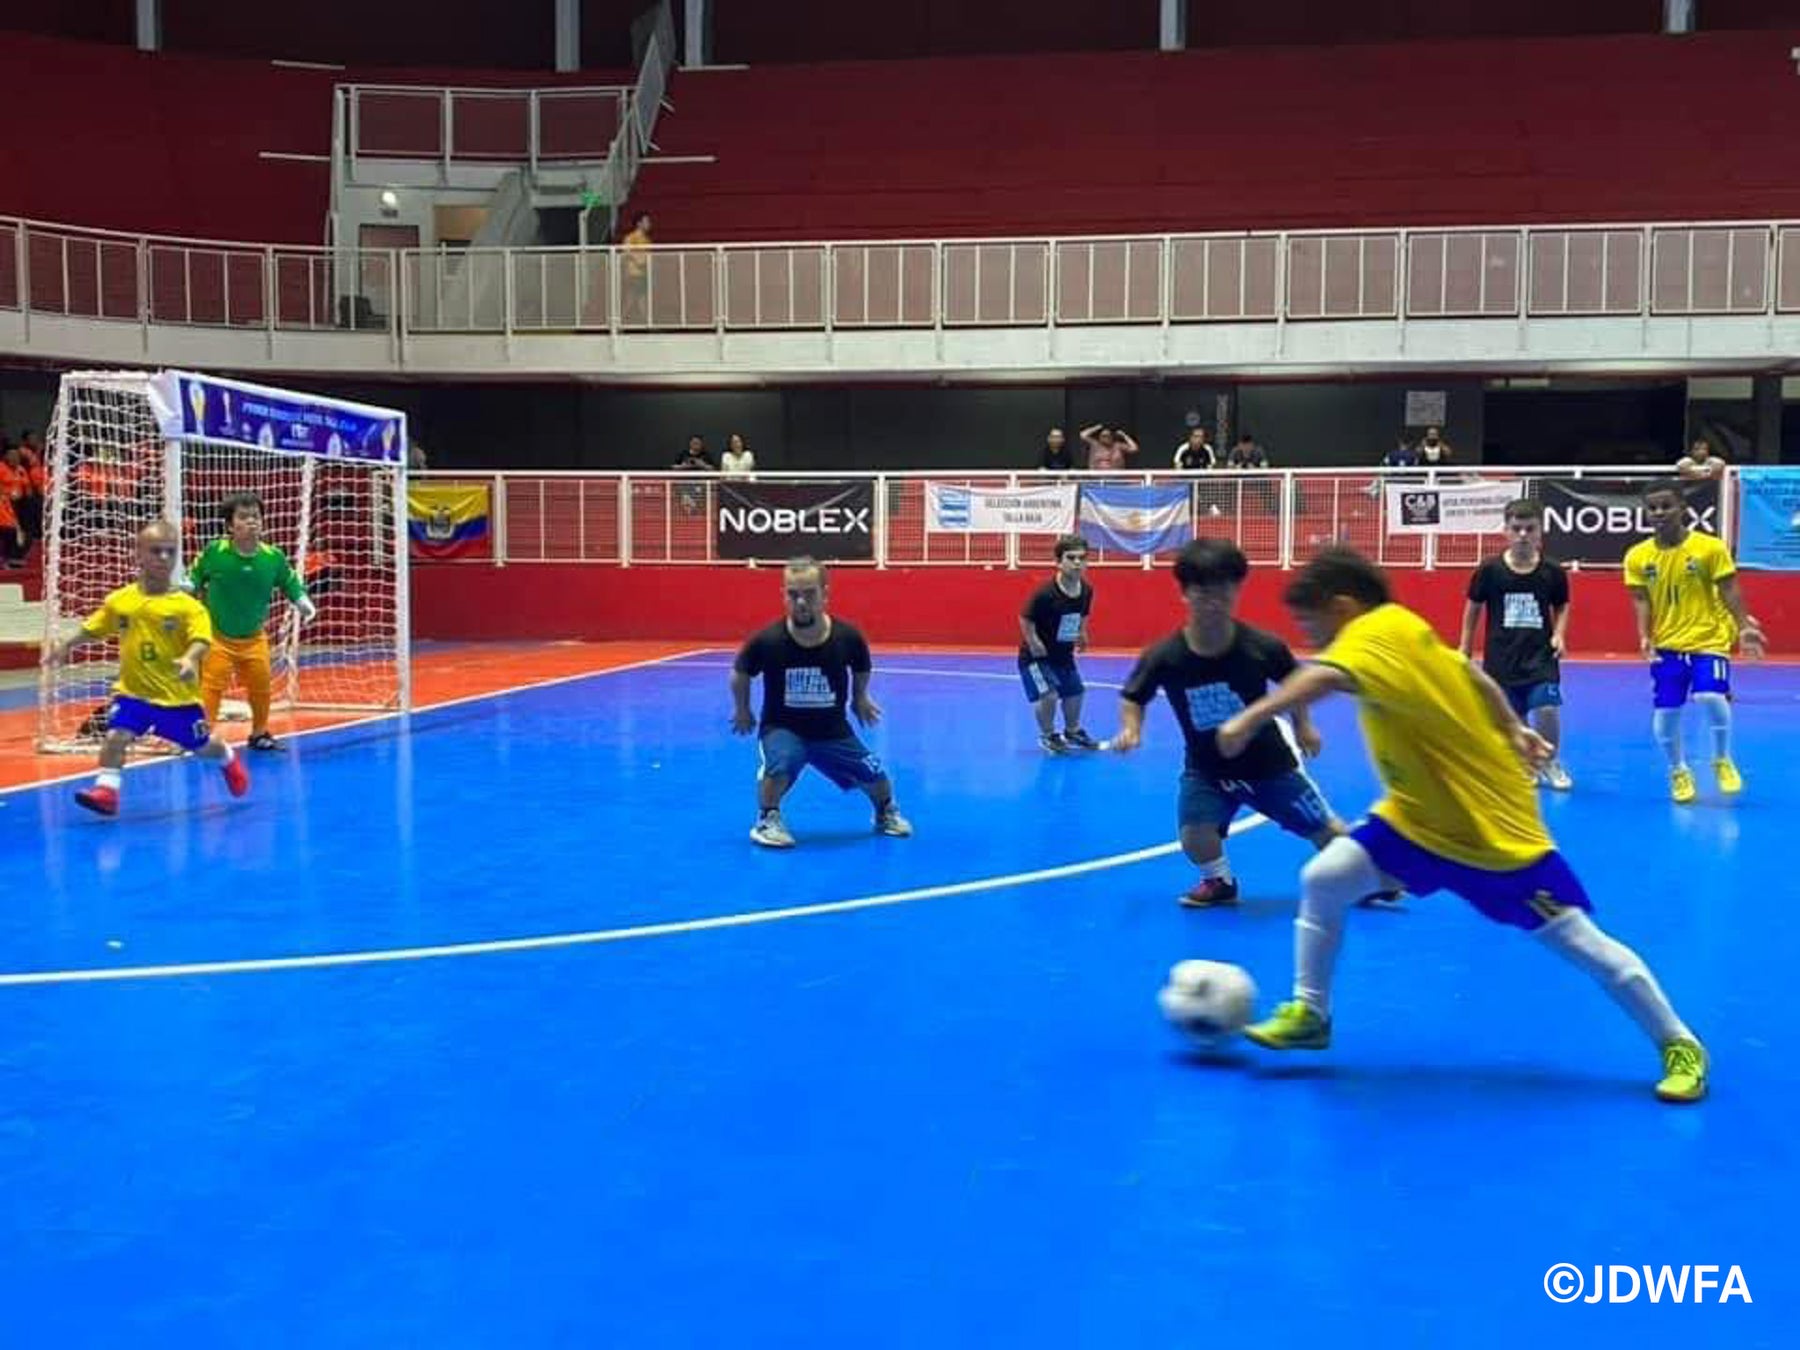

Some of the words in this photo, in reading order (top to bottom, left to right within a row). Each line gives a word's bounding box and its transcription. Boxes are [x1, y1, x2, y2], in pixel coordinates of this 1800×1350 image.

[719, 507, 869, 533] NOBLEX
[1543, 506, 1715, 533] NOBLX
[1713, 659, 1727, 680] 11
